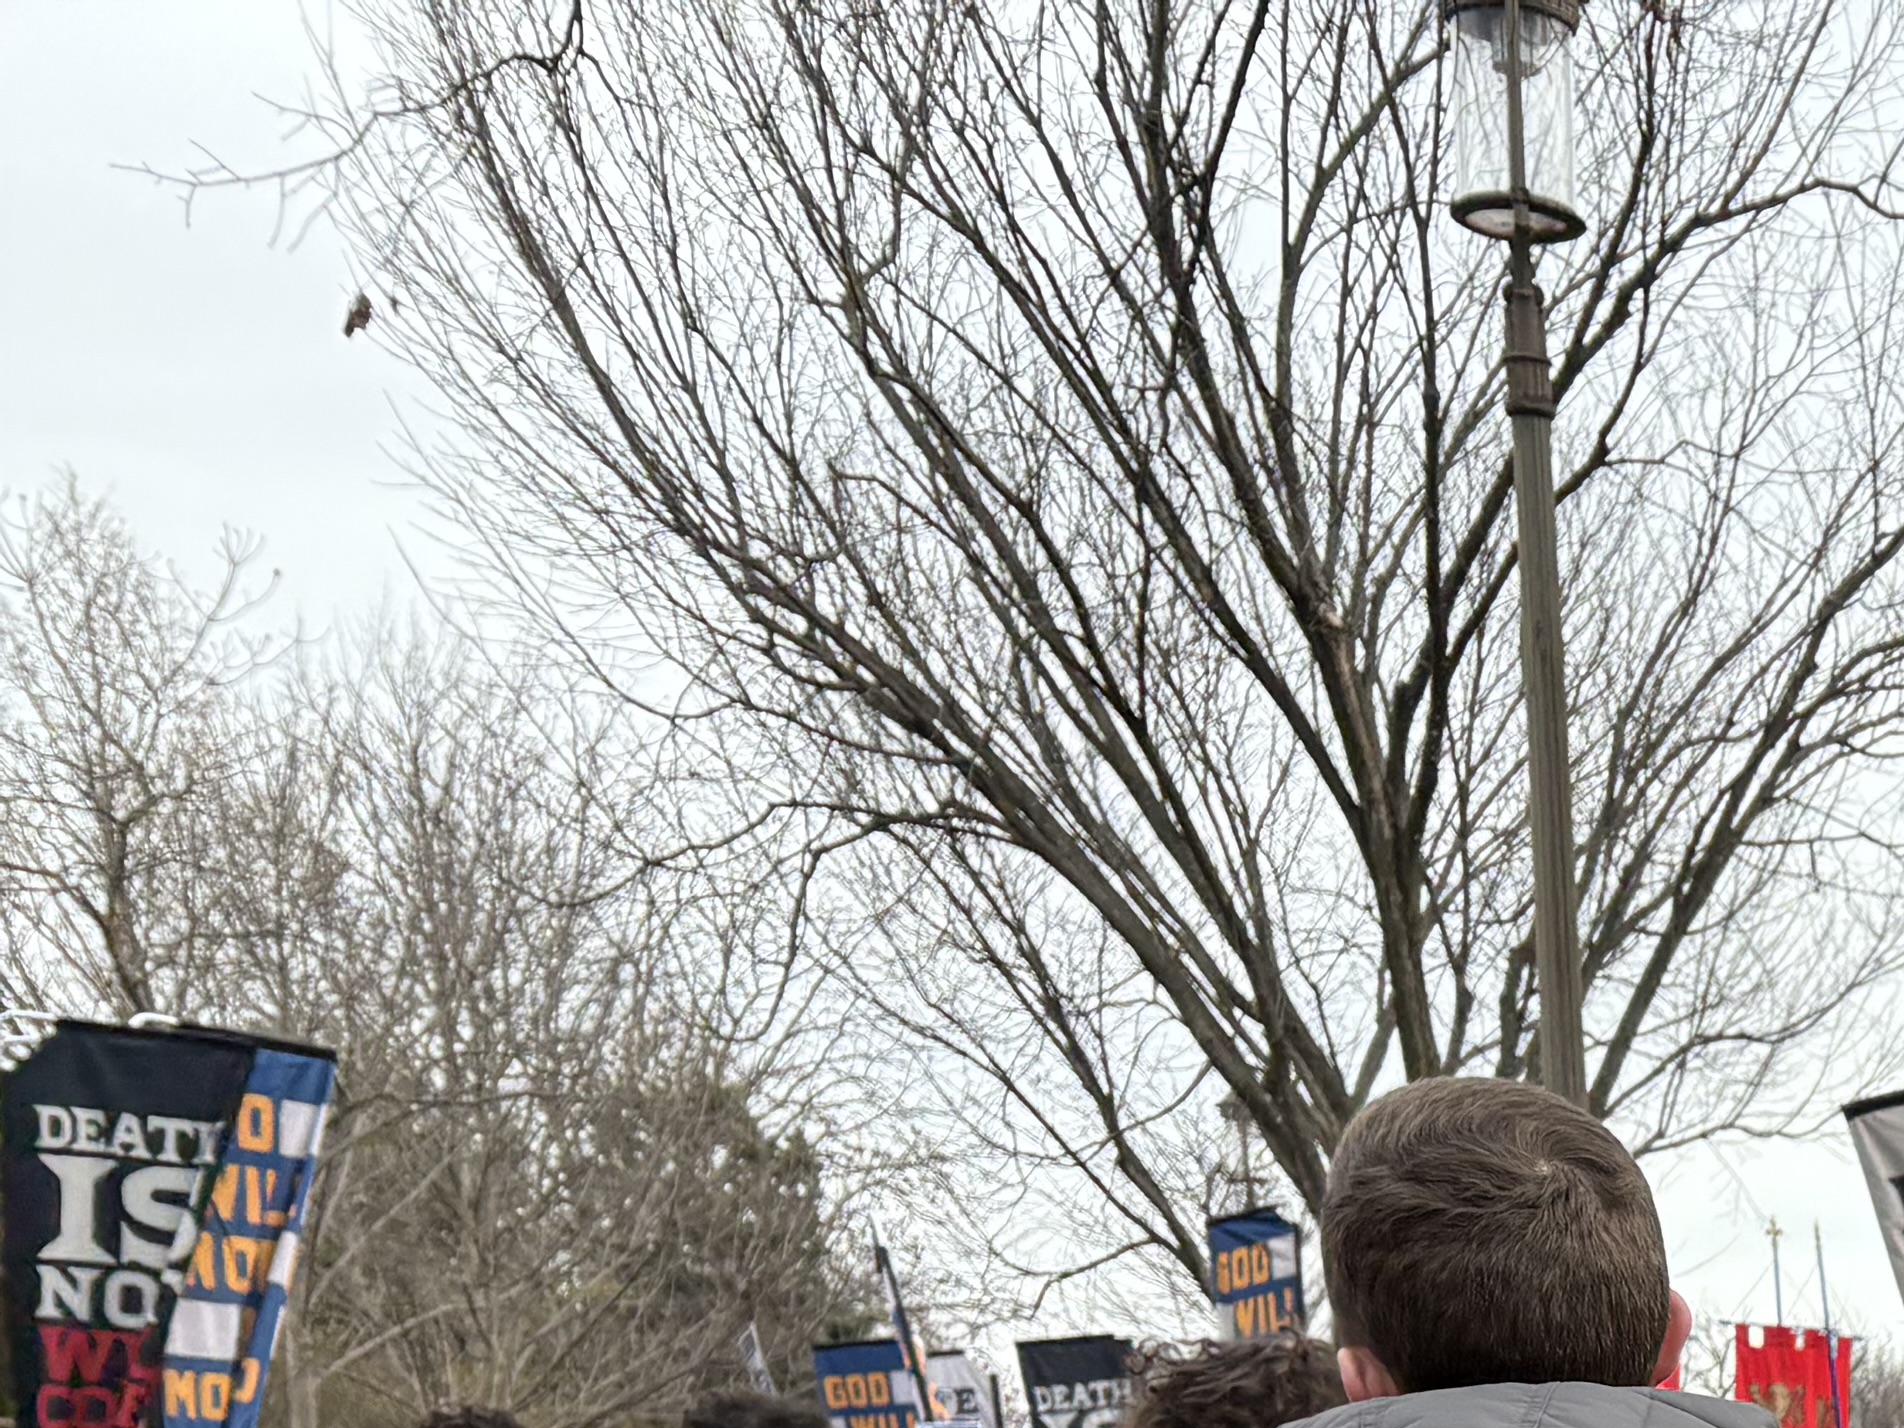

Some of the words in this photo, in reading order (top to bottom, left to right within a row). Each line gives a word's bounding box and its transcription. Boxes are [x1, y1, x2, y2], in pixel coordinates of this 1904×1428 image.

[37, 1152, 200, 1270] IS
[35, 1264, 184, 1328] NO
[823, 1371, 889, 1409] GOD
[1032, 1375, 1133, 1412] DEATH
